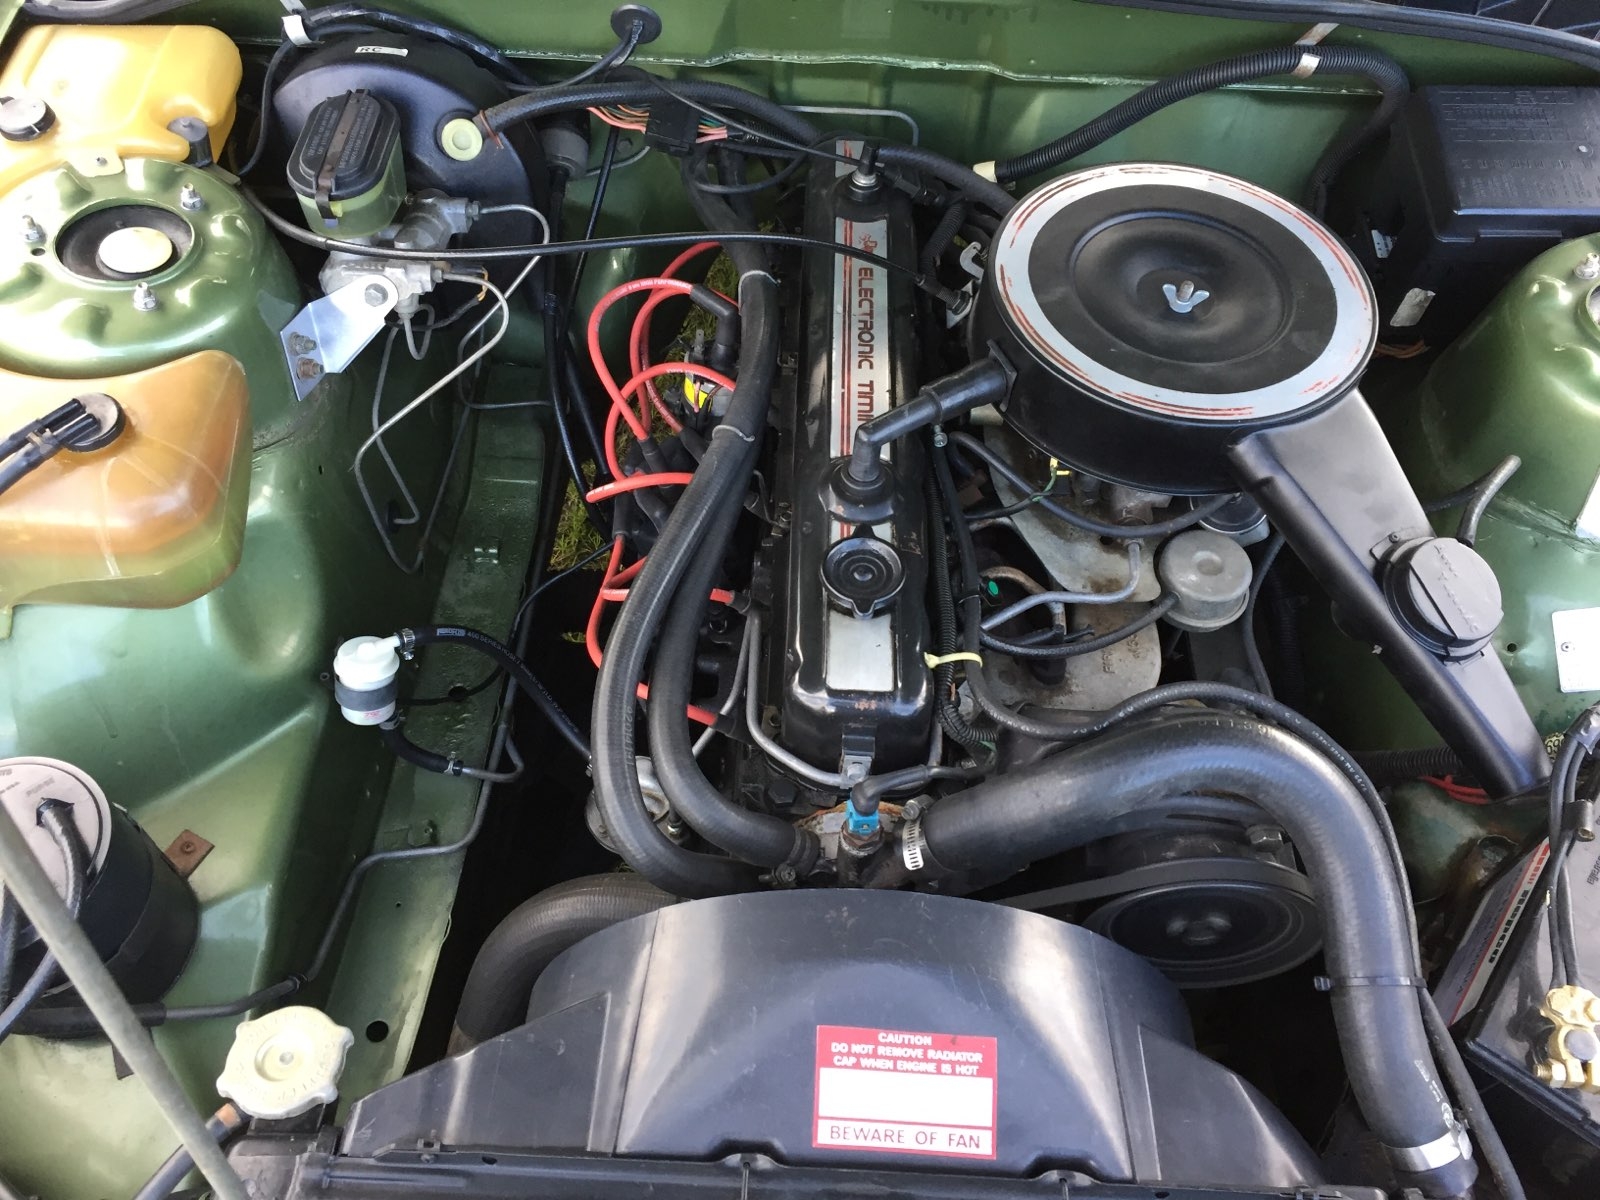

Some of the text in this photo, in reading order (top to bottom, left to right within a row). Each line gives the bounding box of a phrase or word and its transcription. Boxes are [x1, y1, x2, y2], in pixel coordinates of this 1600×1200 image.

[857, 267, 875, 425] ELECTRONIC TIMI
[878, 1032, 932, 1046] CAUTION
[831, 1042, 983, 1063] DO NOT REMOVE RADIATOR
[833, 1055, 979, 1076] CAP WHEN ENGINE IS HOT
[830, 1125, 980, 1149] BEWARE OF FAN
